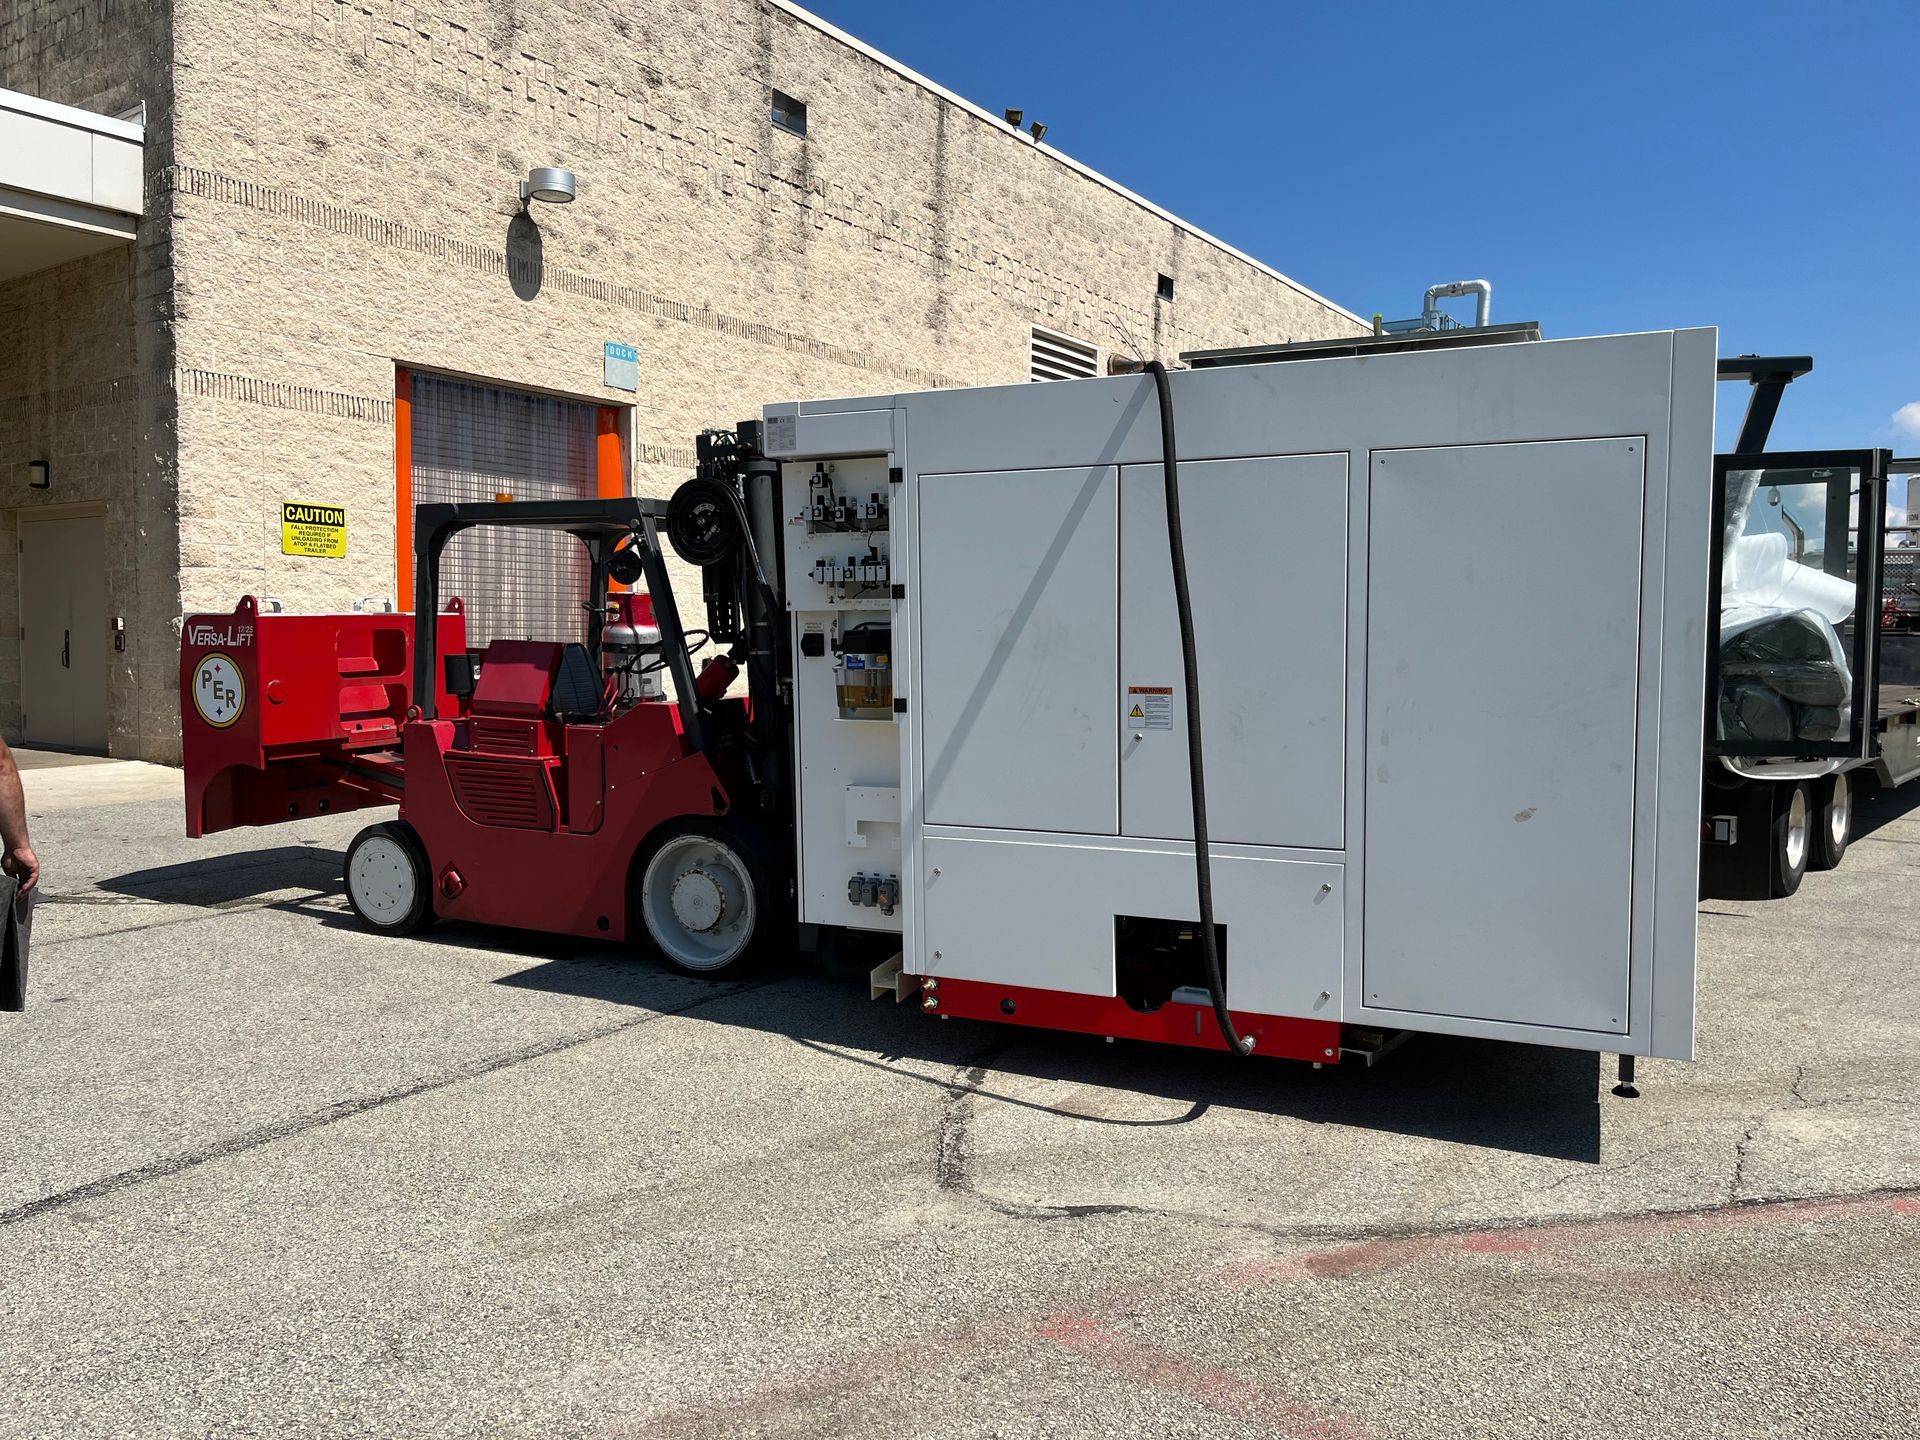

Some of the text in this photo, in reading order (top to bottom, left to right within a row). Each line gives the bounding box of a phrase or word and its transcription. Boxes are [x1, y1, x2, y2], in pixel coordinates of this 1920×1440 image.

[609, 345, 633, 359] DOCK
[286, 506, 343, 524] CAUTION
[305, 525, 339, 533] PROTECTION
[188, 625, 254, 646] VERSA-LIFT
